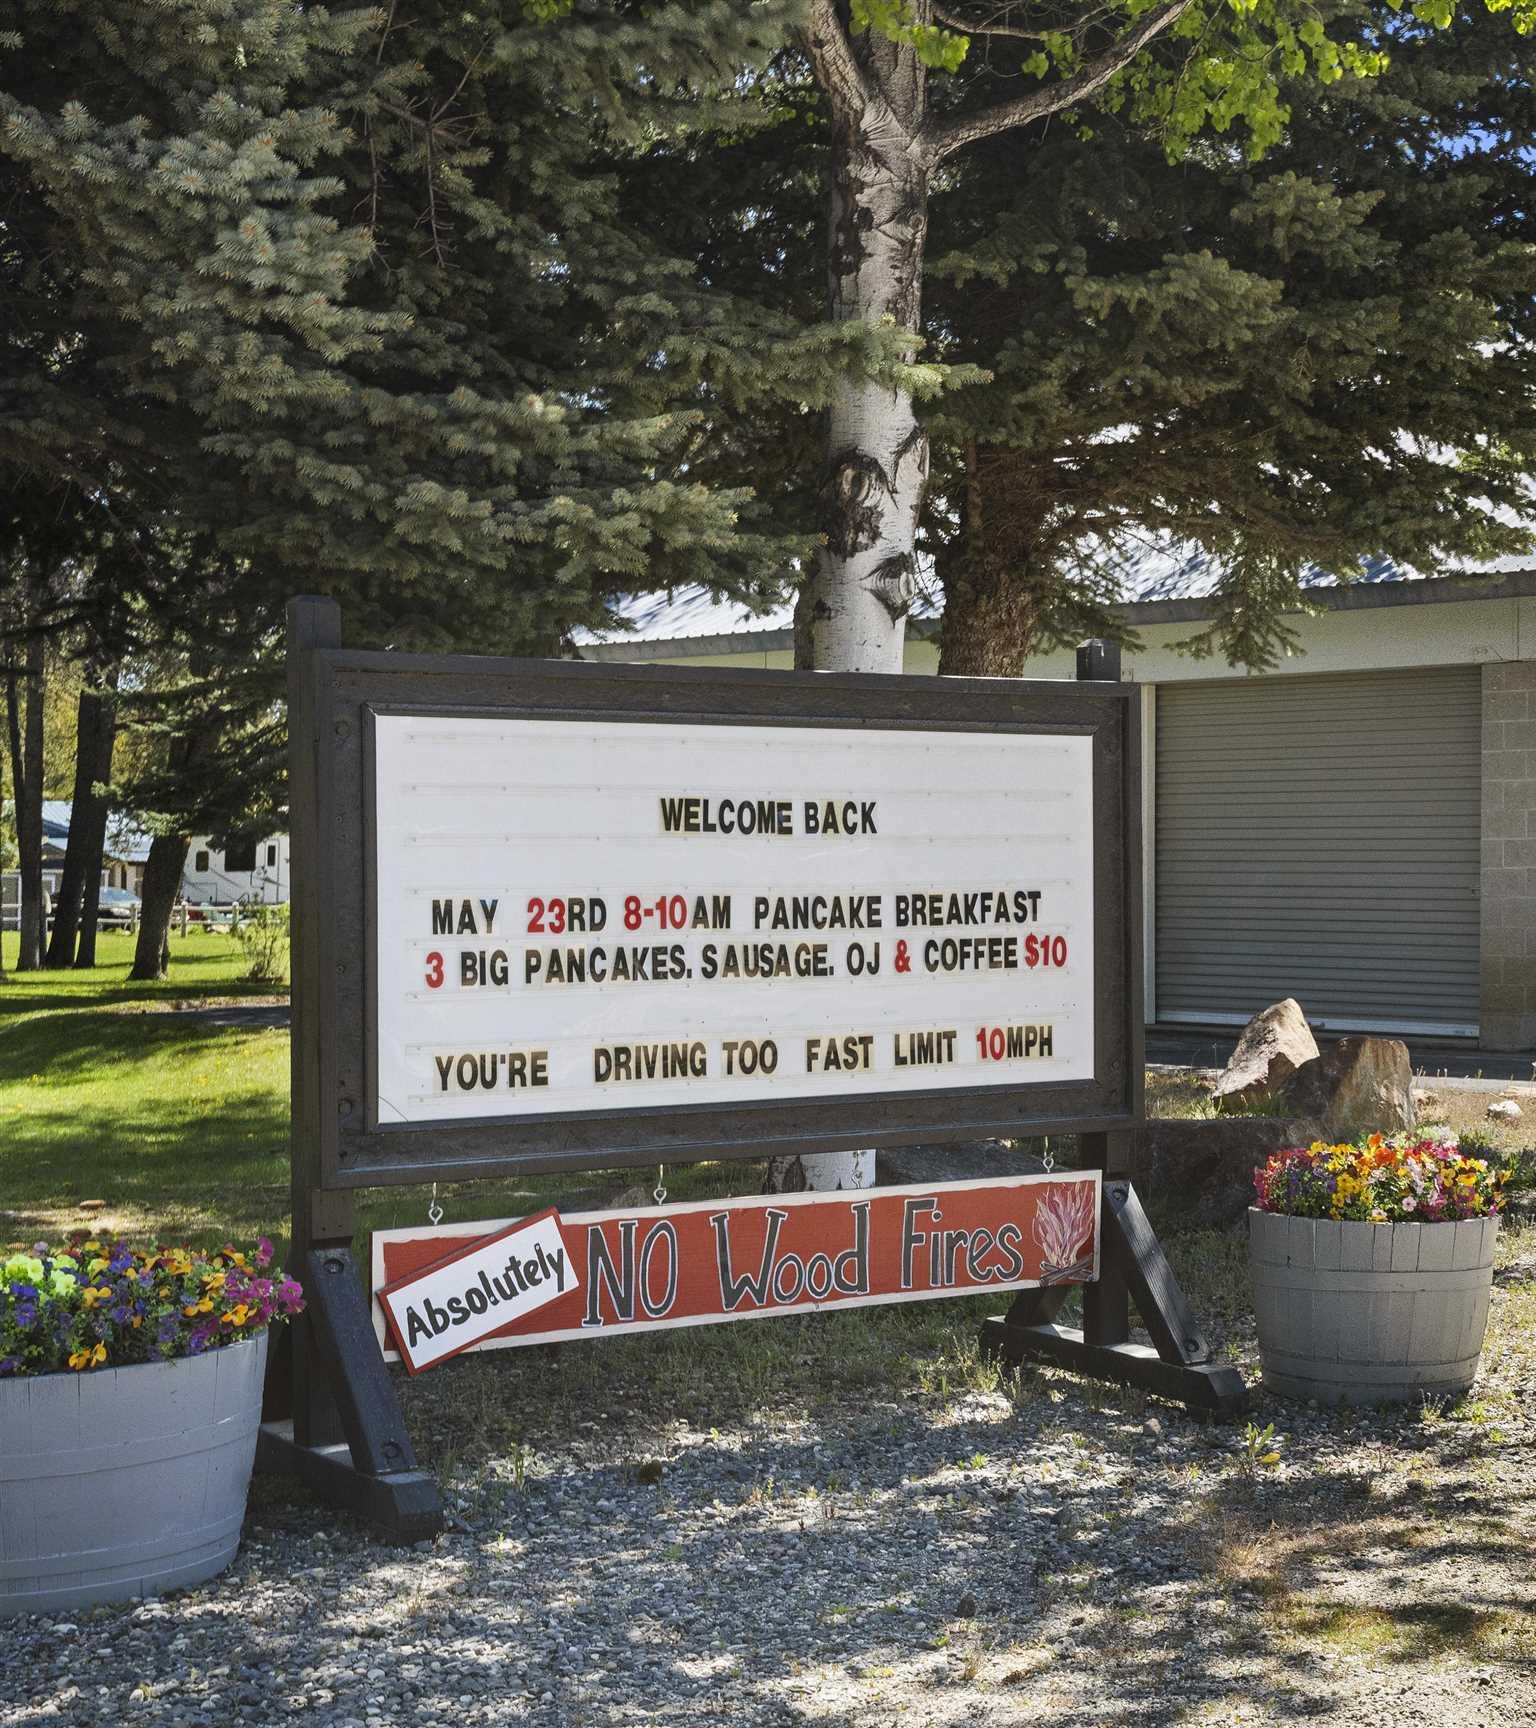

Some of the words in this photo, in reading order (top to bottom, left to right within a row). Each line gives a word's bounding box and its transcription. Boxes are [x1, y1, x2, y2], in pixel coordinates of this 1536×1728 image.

[660, 797, 794, 835] WELCOME
[804, 800, 878, 836] BACK
[432, 899, 499, 936] MAY
[527, 897, 607, 934] 23RD
[624, 894, 732, 931] 8-10AM
[754, 894, 883, 930] PANCAKE
[895, 890, 1042, 927] BREAKFAST
[425, 952, 445, 989] 3
[460, 949, 509, 986] BIG
[846, 941, 880, 977] OJ
[894, 938, 912, 974] &
[924, 936, 1018, 973] COFFEE
[1024, 933, 1068, 968] $10
[434, 1051, 549, 1092] YOU'RE
[594, 1042, 707, 1084] DRIVING
[722, 1039, 779, 1076] TOO
[806, 1035, 874, 1073] FAST
[894, 1030, 958, 1067] LIMIT
[976, 1025, 1054, 1061] 10MPH
[581, 1219, 679, 1328] NO
[710, 1201, 870, 1312] Wood
[900, 1197, 1024, 1289] Fires
[406, 1242, 564, 1348] Absolutely
